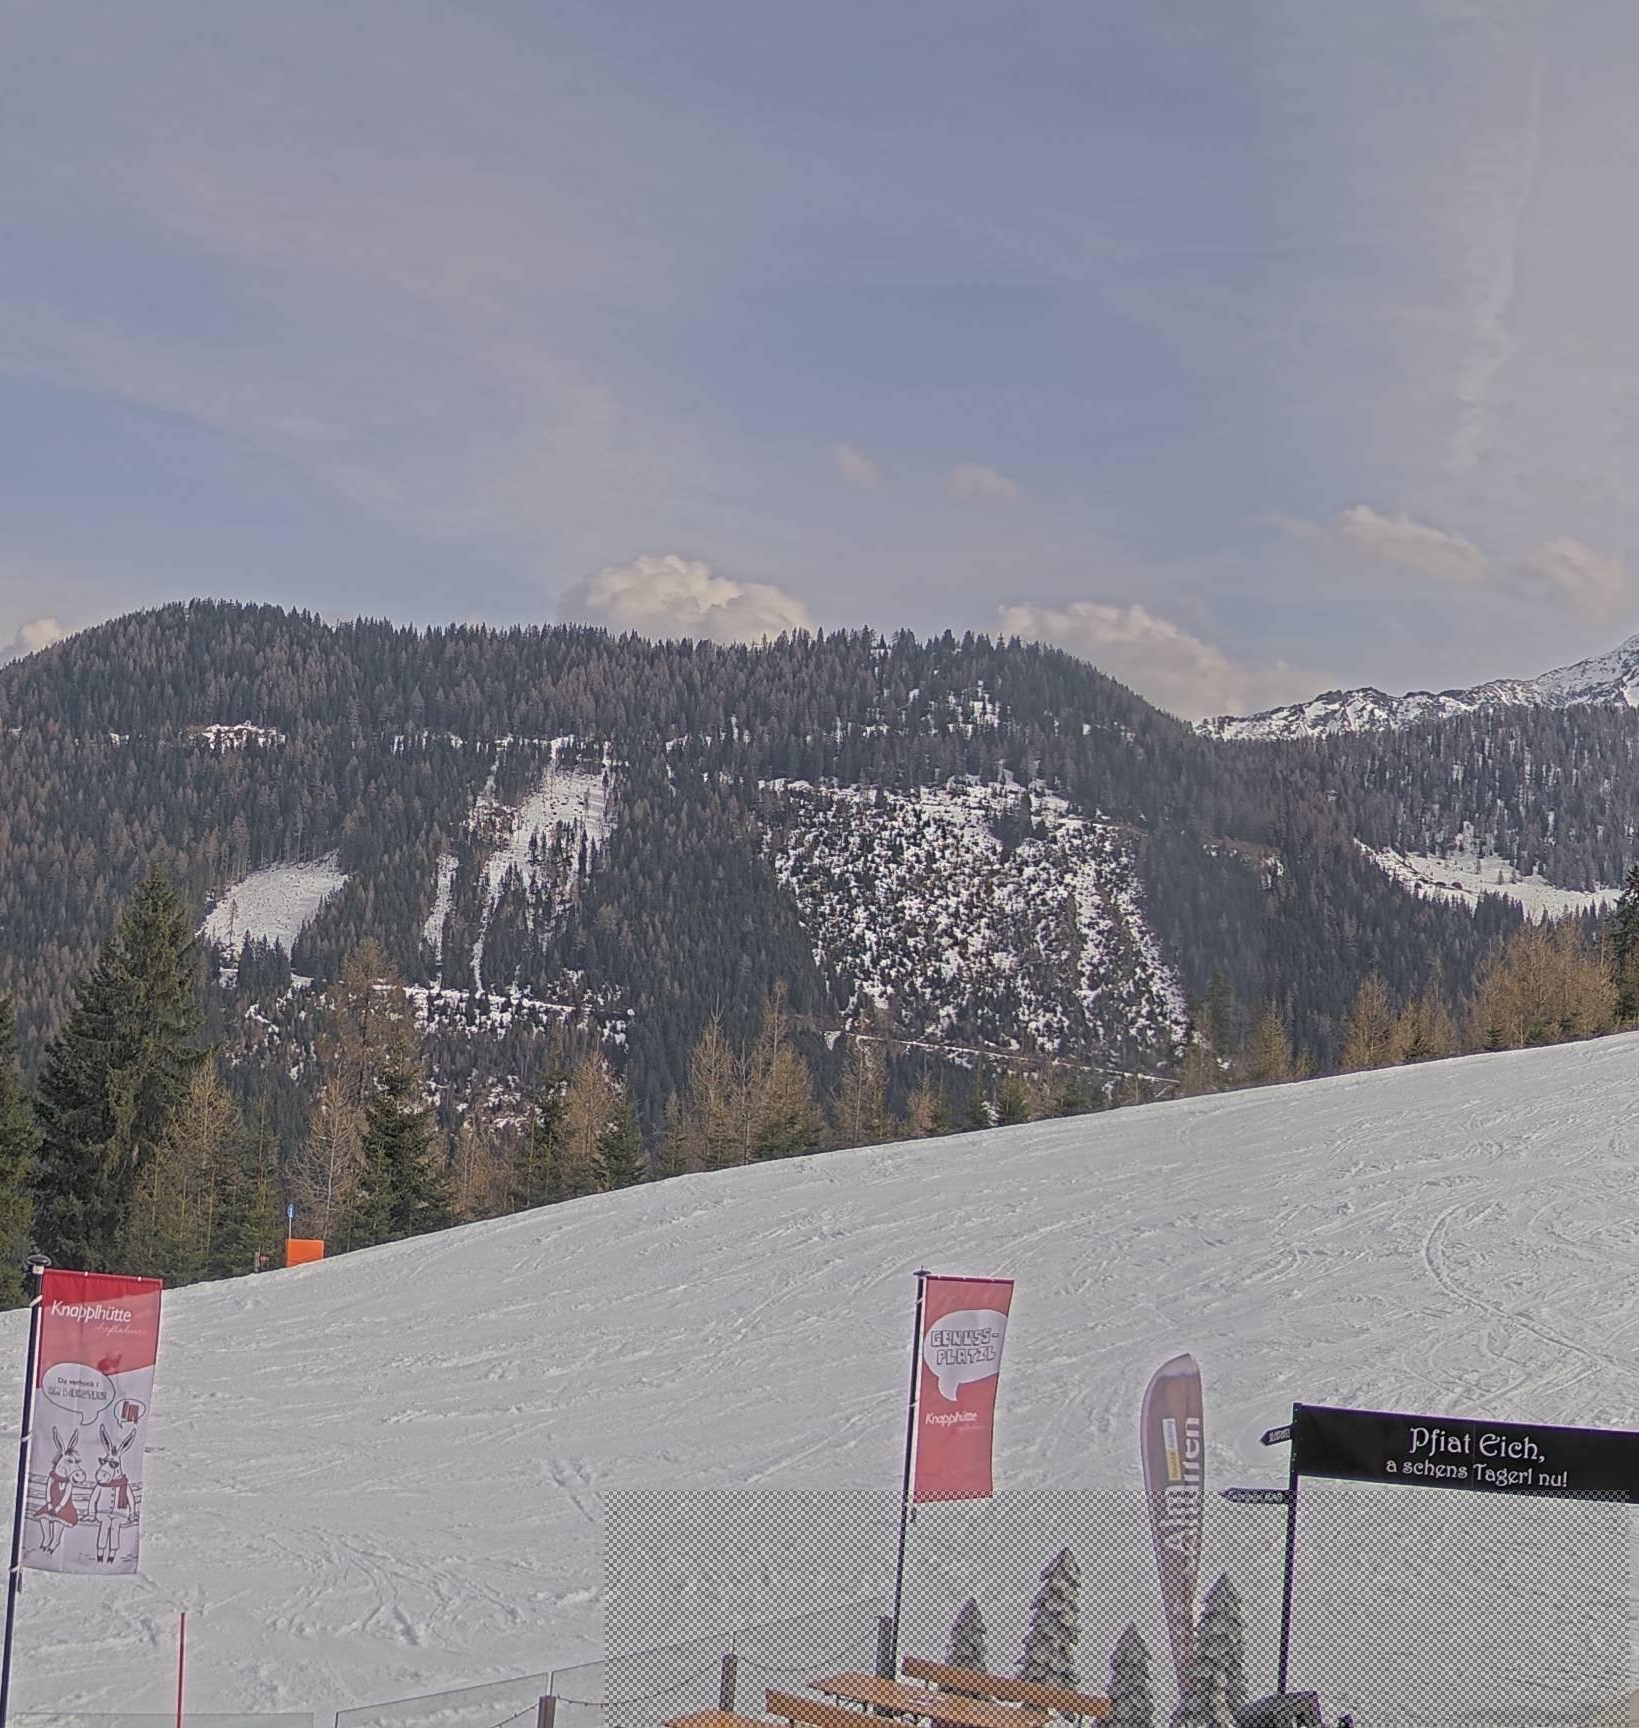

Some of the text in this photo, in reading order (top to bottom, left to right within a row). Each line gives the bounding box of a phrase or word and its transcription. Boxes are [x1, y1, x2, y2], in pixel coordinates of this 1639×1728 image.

[51, 1300, 131, 1322] Knapplhütte
[931, 1328, 999, 1347] GENUSS-
[937, 1346, 996, 1365] PLATZL
[1409, 1427, 1545, 1464] Pfiat Eich,
[1386, 1459, 1568, 1488] a schens Tagerl nu!
